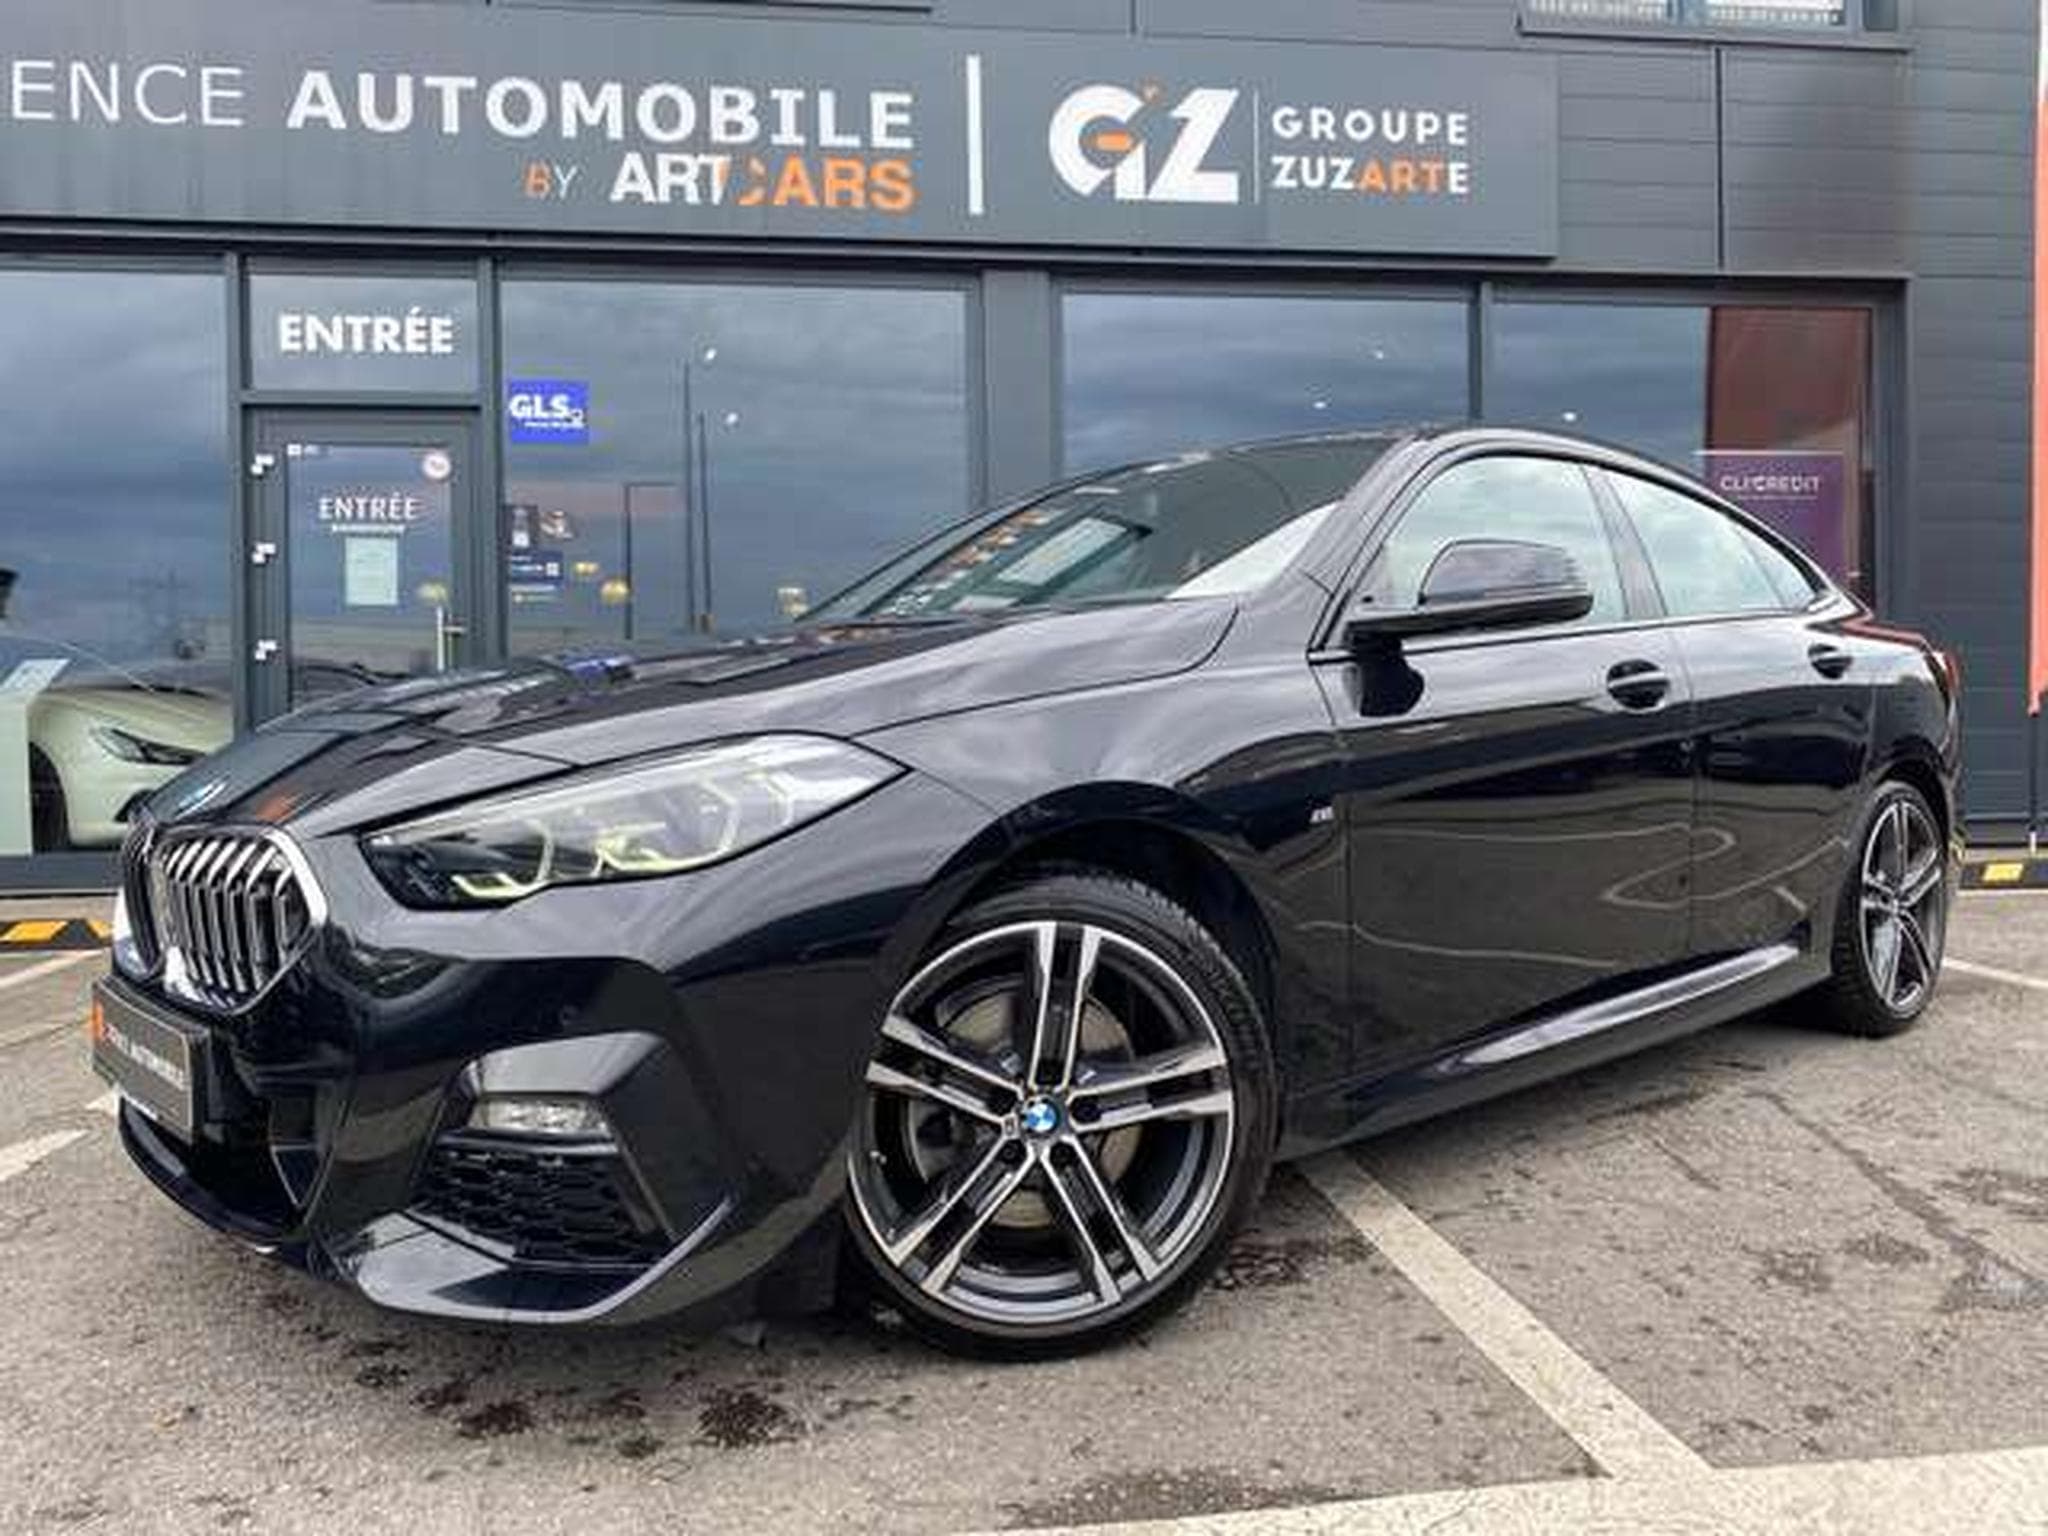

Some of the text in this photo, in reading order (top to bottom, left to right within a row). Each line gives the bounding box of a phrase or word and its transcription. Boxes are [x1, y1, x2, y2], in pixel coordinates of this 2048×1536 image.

[12, 59, 915, 149] ENCE AUTOMOBILE
[1271, 105, 1470, 146] GROUPE
[523, 160, 577, 198] BY
[1271, 154, 1471, 195] ZUZARTE
[279, 306, 454, 354] ENTRÉE
[509, 393, 569, 419] GLS
[319, 491, 417, 520] ENTRÉE
